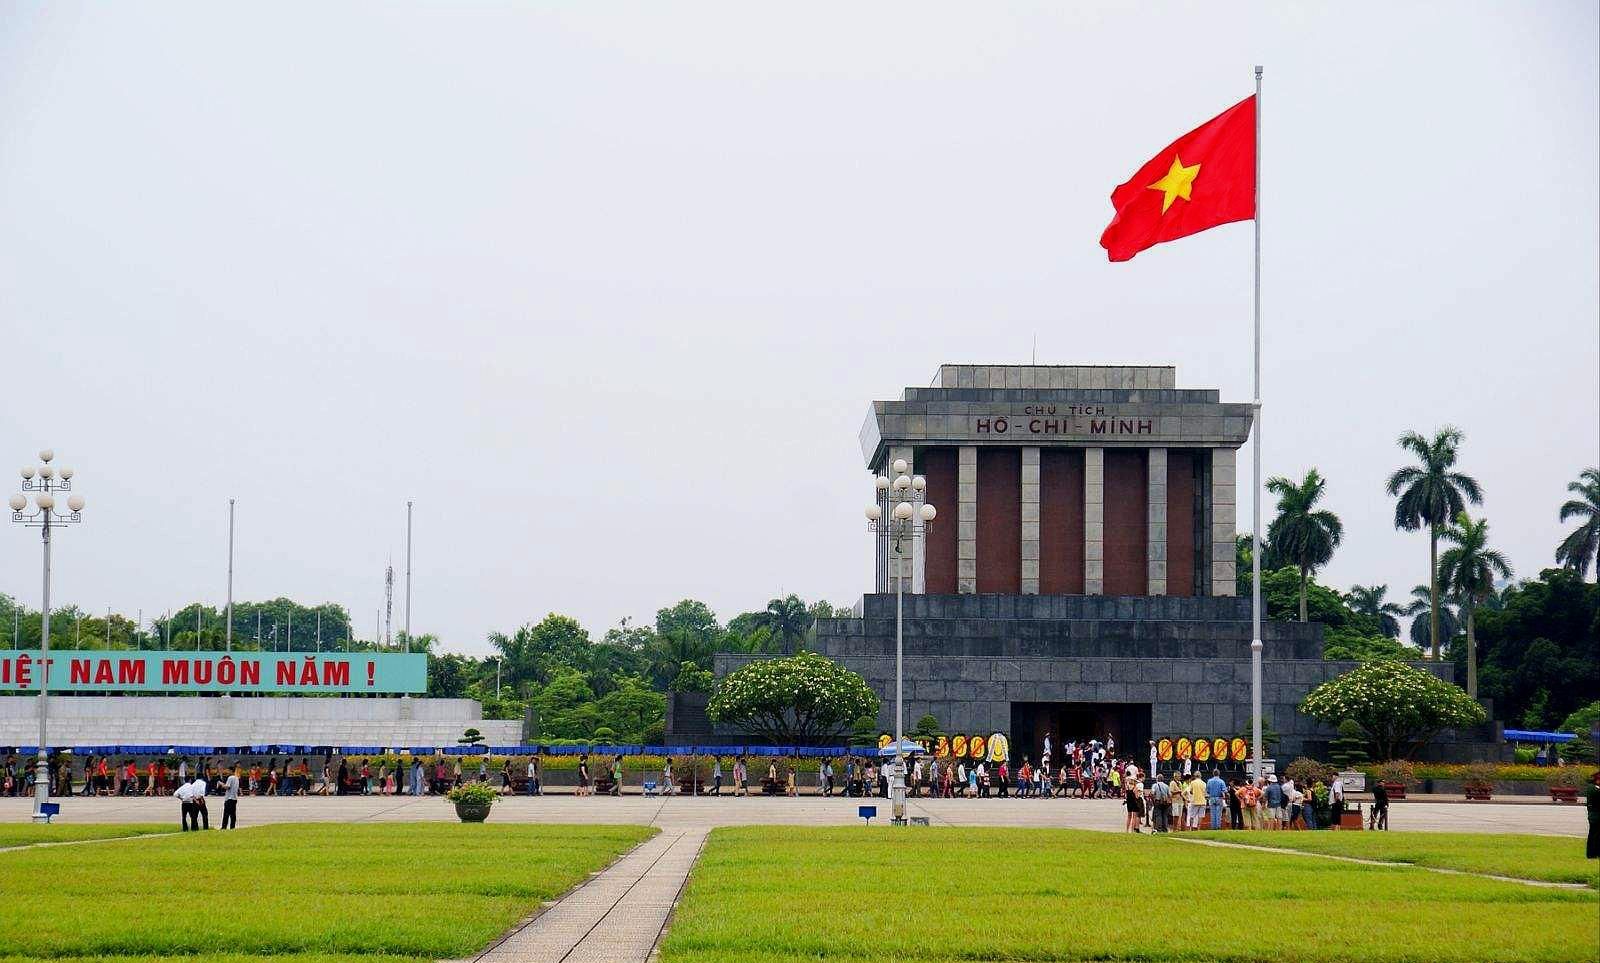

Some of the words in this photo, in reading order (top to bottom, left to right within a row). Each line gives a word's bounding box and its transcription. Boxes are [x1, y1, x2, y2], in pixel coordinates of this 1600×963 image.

[71, 659, 145, 684] NAM
[162, 655, 260, 685] MUÔN
[277, 655, 350, 686] NĂM
